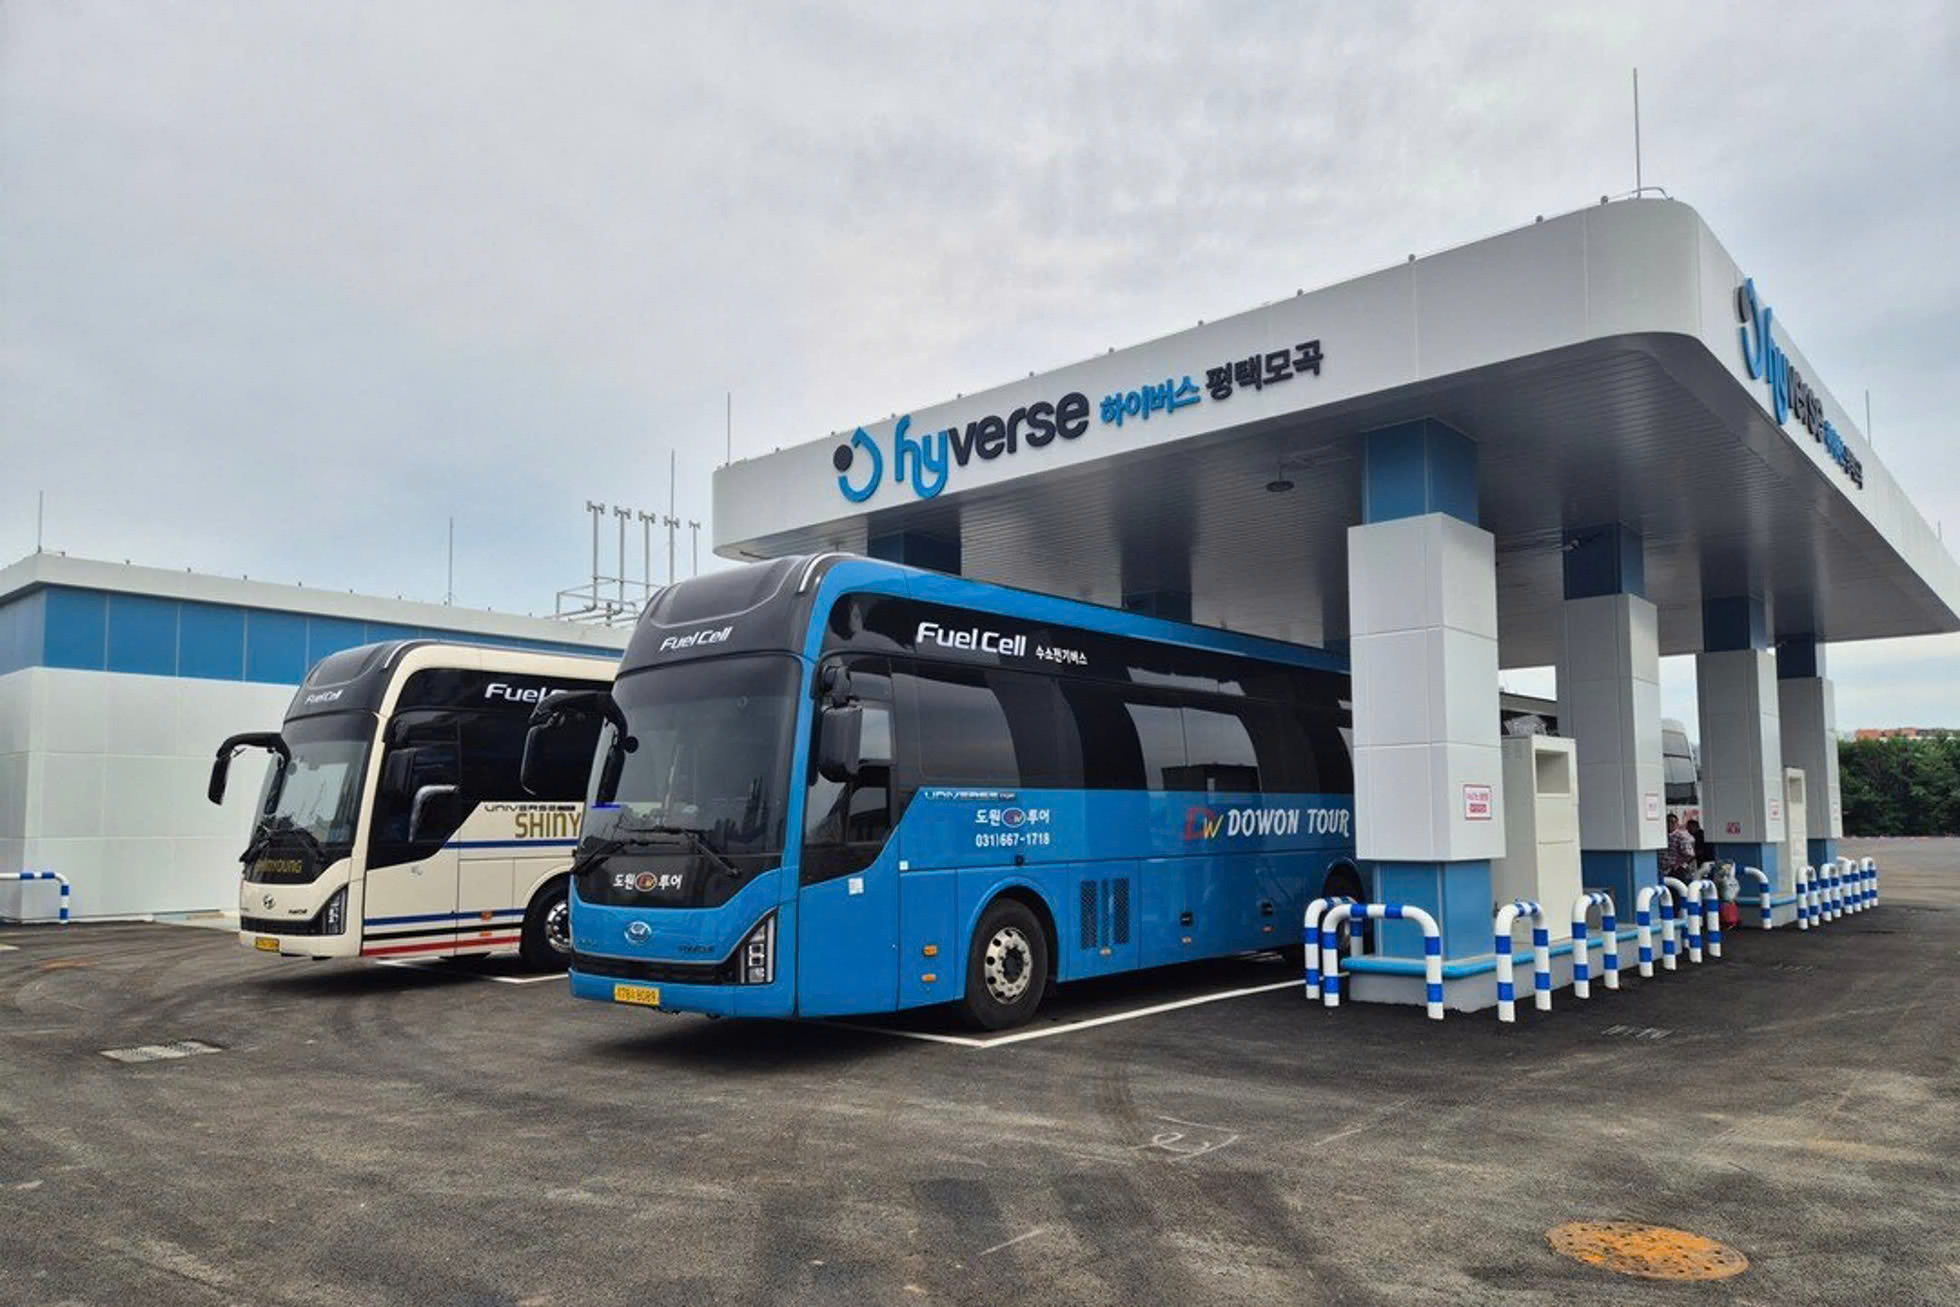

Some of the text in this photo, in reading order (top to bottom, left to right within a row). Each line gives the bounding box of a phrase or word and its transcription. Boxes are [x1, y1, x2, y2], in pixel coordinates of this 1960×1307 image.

[1099, 339, 1324, 427] 하이버스 평택모곡
[894, 391, 1090, 499] hyverse
[1227, 808, 1350, 838] DOWON TOUR
